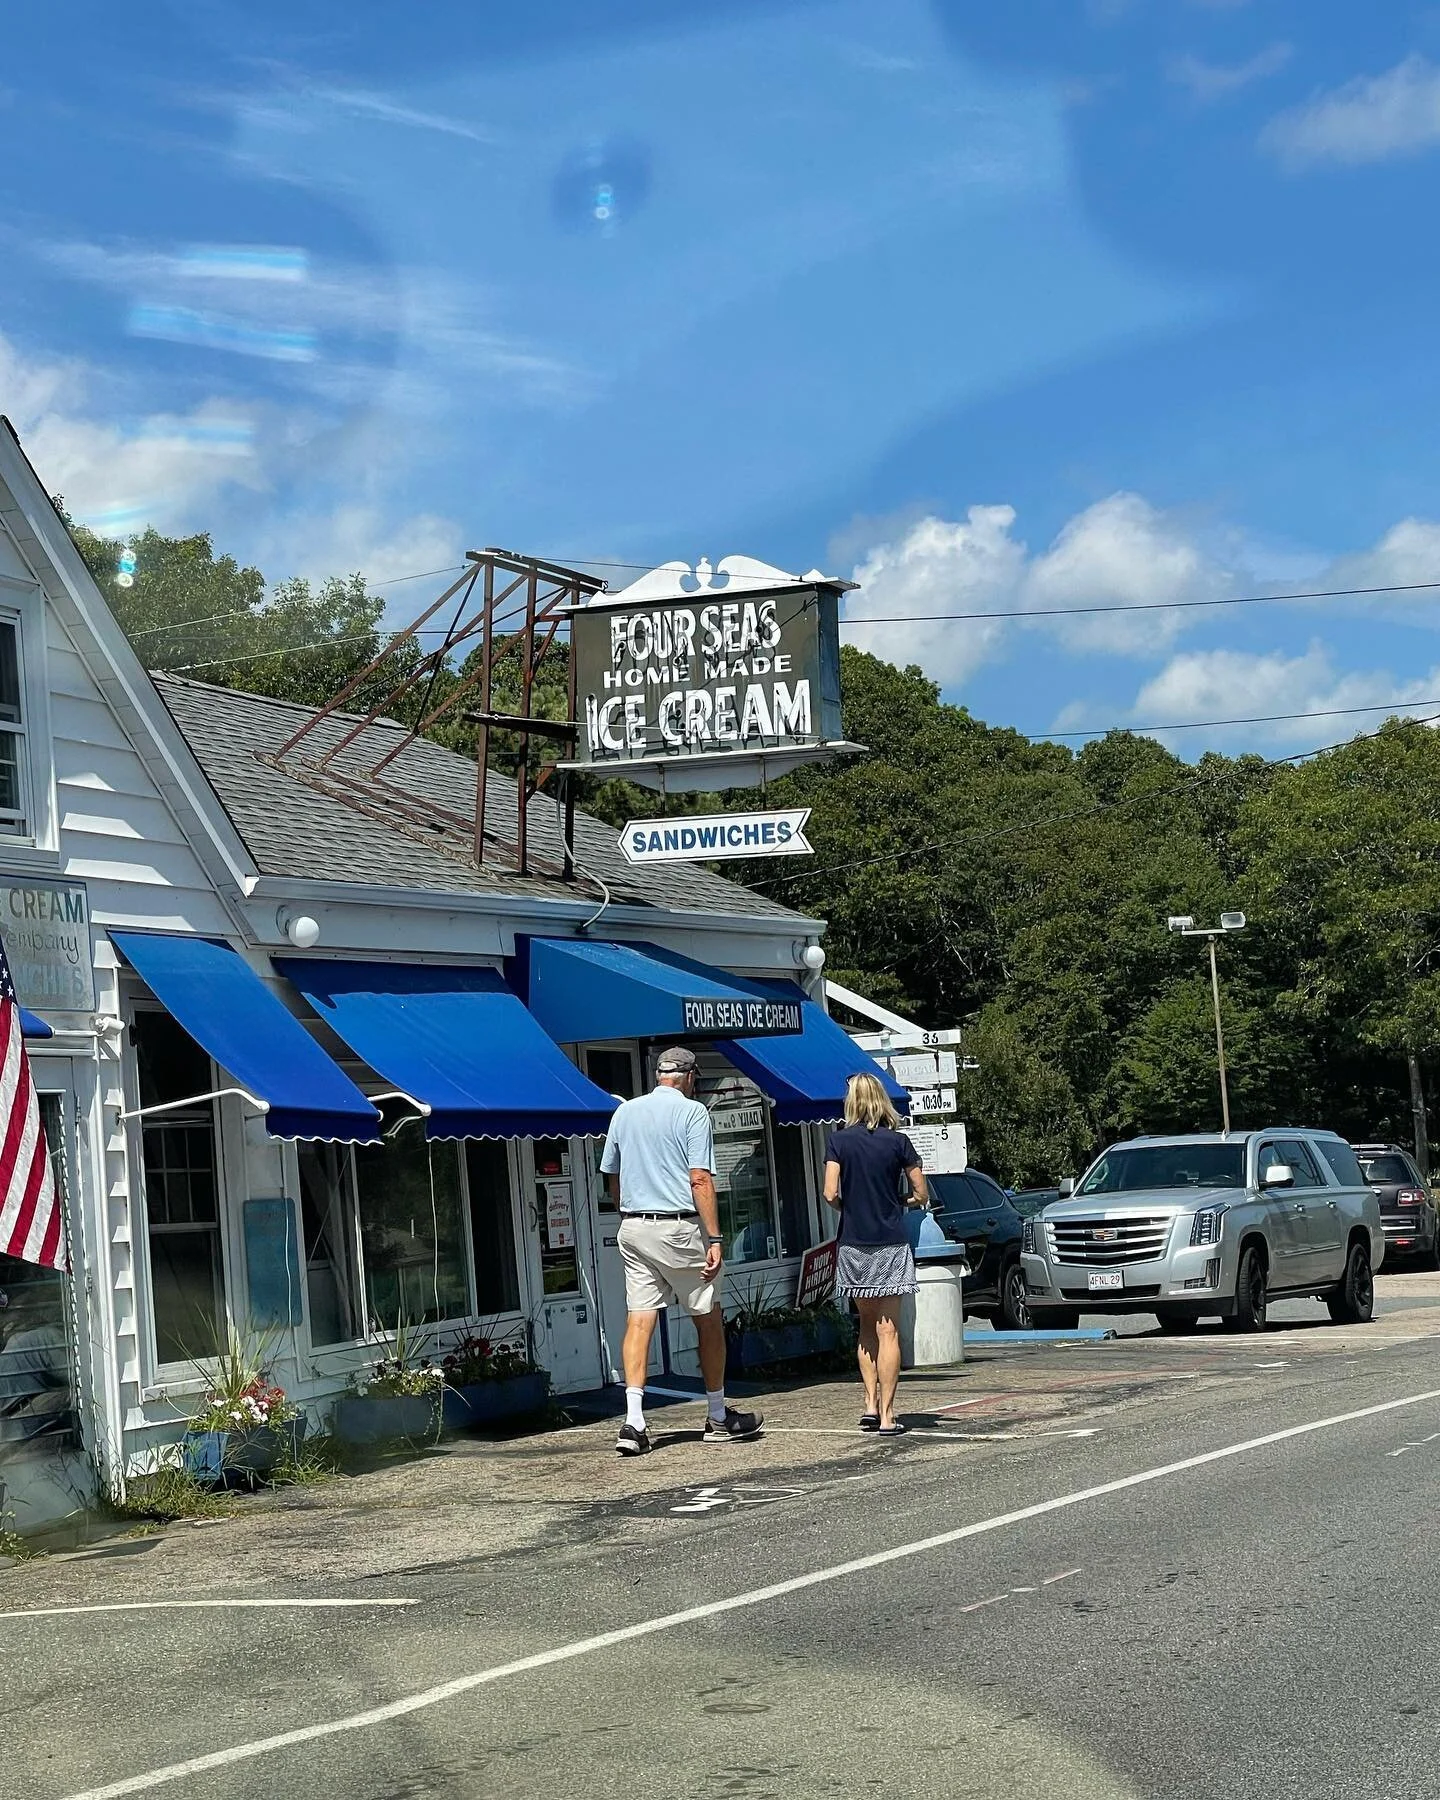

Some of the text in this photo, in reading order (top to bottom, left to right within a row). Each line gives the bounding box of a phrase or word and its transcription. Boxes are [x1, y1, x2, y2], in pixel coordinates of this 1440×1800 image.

[610, 600, 782, 663] FOUR SEAS
[603, 654, 792, 688] HOME MADE
[585, 679, 812, 752] ICE CREAM
[632, 821, 791, 853] SANDWICHES
[9, 887, 84, 924] CREAM
[685, 1002, 800, 1029] FOUR SEAS ICE CREAM
